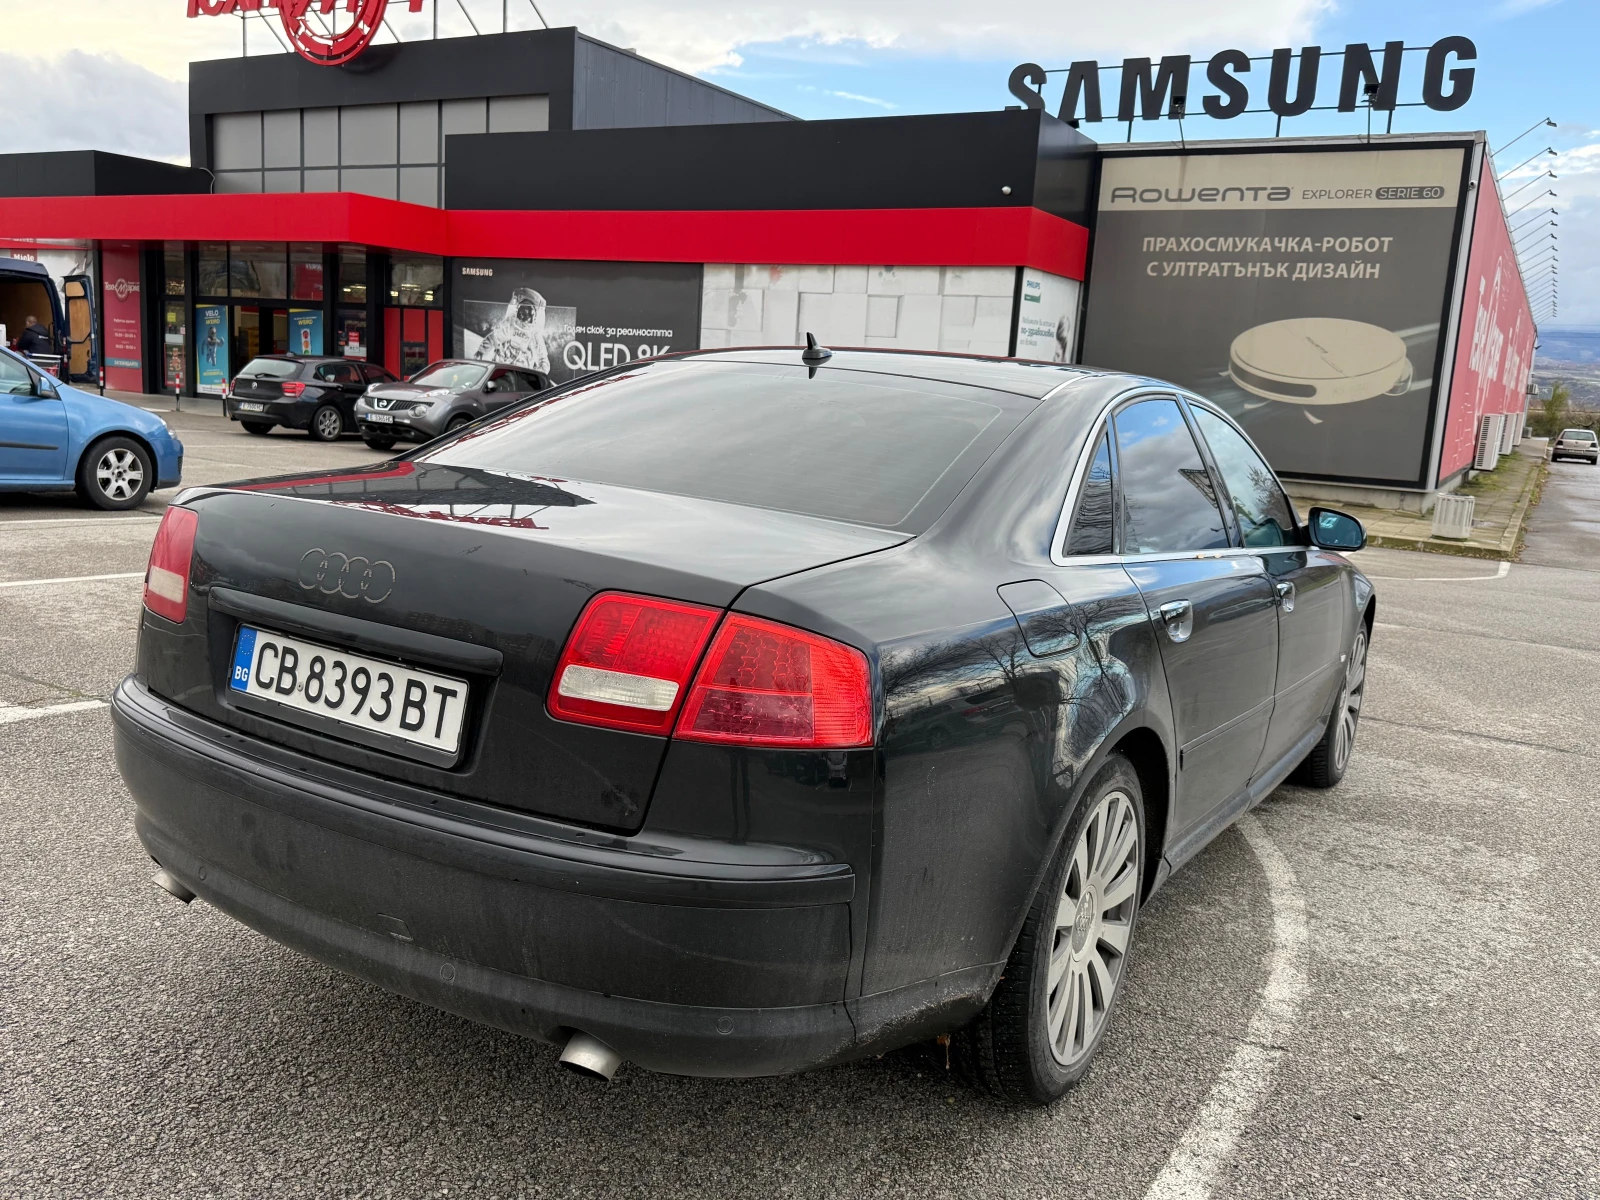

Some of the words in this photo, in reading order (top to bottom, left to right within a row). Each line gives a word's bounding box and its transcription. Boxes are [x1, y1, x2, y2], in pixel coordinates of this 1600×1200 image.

[1008, 35, 1477, 122] SAMSUNG
[1302, 188, 1372, 200] EXPLORER
[1379, 187, 1420, 199] SERIE
[1422, 187, 1441, 199] 60
[1142, 237, 1393, 253] ПРАХОСМУКАЧКА-РОБОТ
[462, 267, 493, 277] SAMSUNG
[1146, 261, 1158, 277] С
[1162, 261, 1289, 278] УЛТРАТЪНЪК
[1292, 260, 1380, 281] ДИЗАЙН
[564, 324, 586, 334] Голям
[586, 325, 605, 335] скок
[605, 327, 616, 338] за
[617, 327, 673, 339] реалността
[563, 340, 630, 371] QLED
[234, 665, 249, 682] BG
[255, 641, 299, 696] CB
[303, 655, 394, 723] 8393
[399, 678, 458, 739] BT
